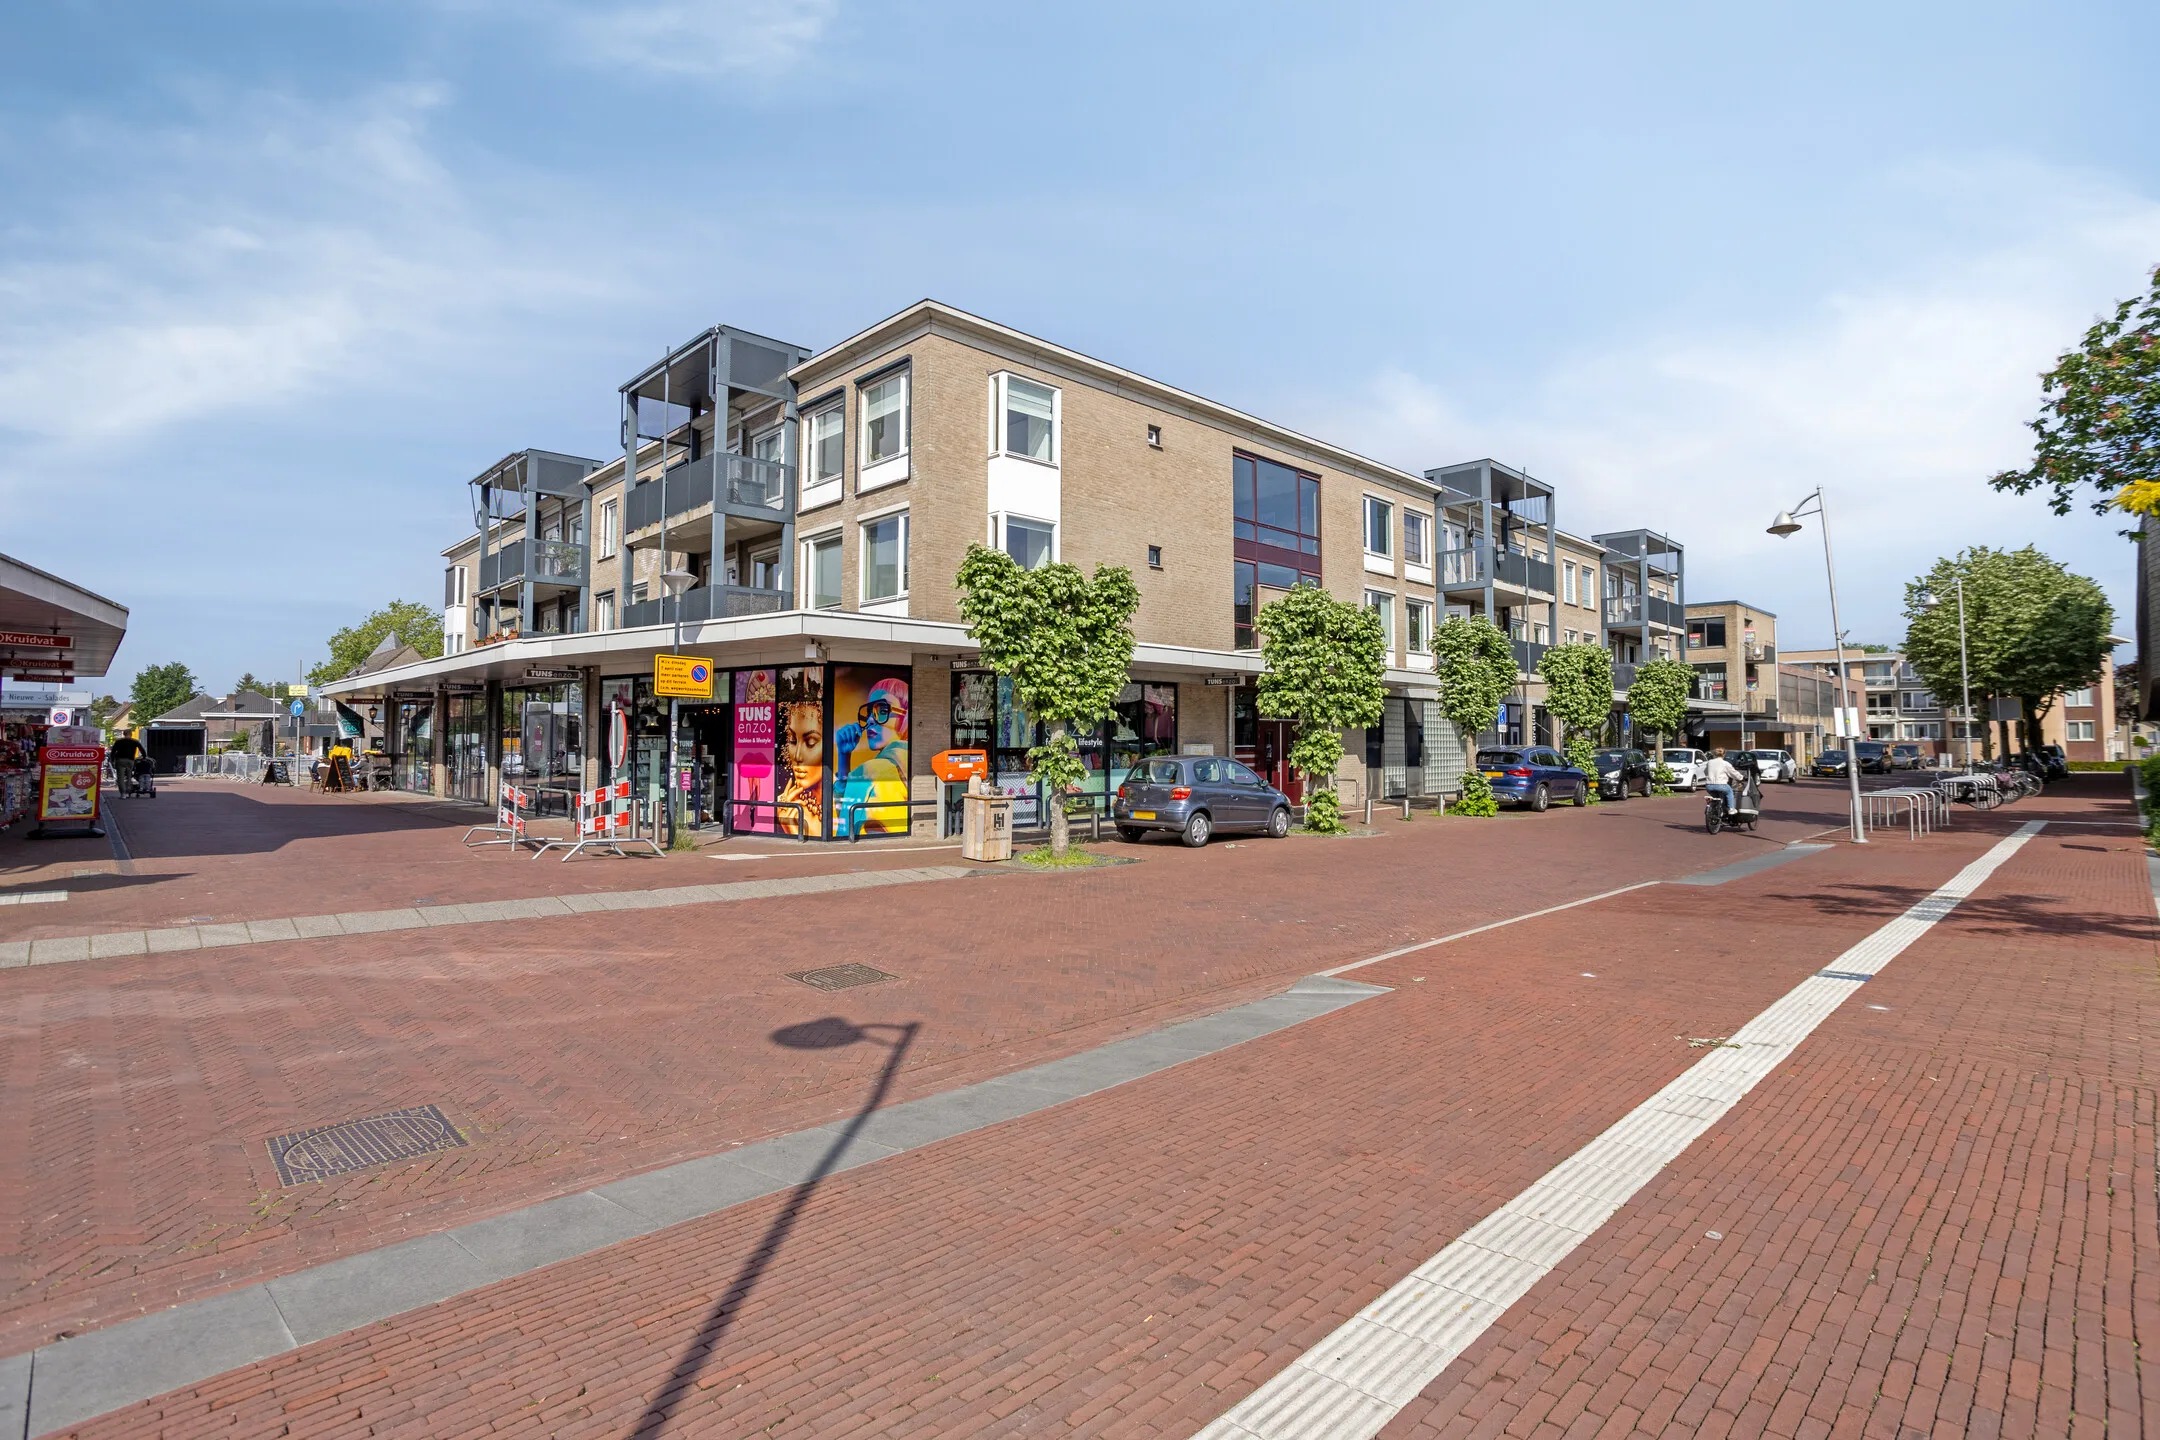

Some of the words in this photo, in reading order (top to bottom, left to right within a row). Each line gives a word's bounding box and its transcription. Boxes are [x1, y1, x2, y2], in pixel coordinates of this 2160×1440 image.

[5, 634, 55, 645] Kruidvat
[22, 660, 60, 668] Kruidvat
[8, 693, 34, 701] Nieuwe
[45, 694, 70, 702] Salades
[738, 706, 772, 721] TUNS
[738, 723, 772, 734] enzo.
[1078, 738, 1103, 747] lifestyle
